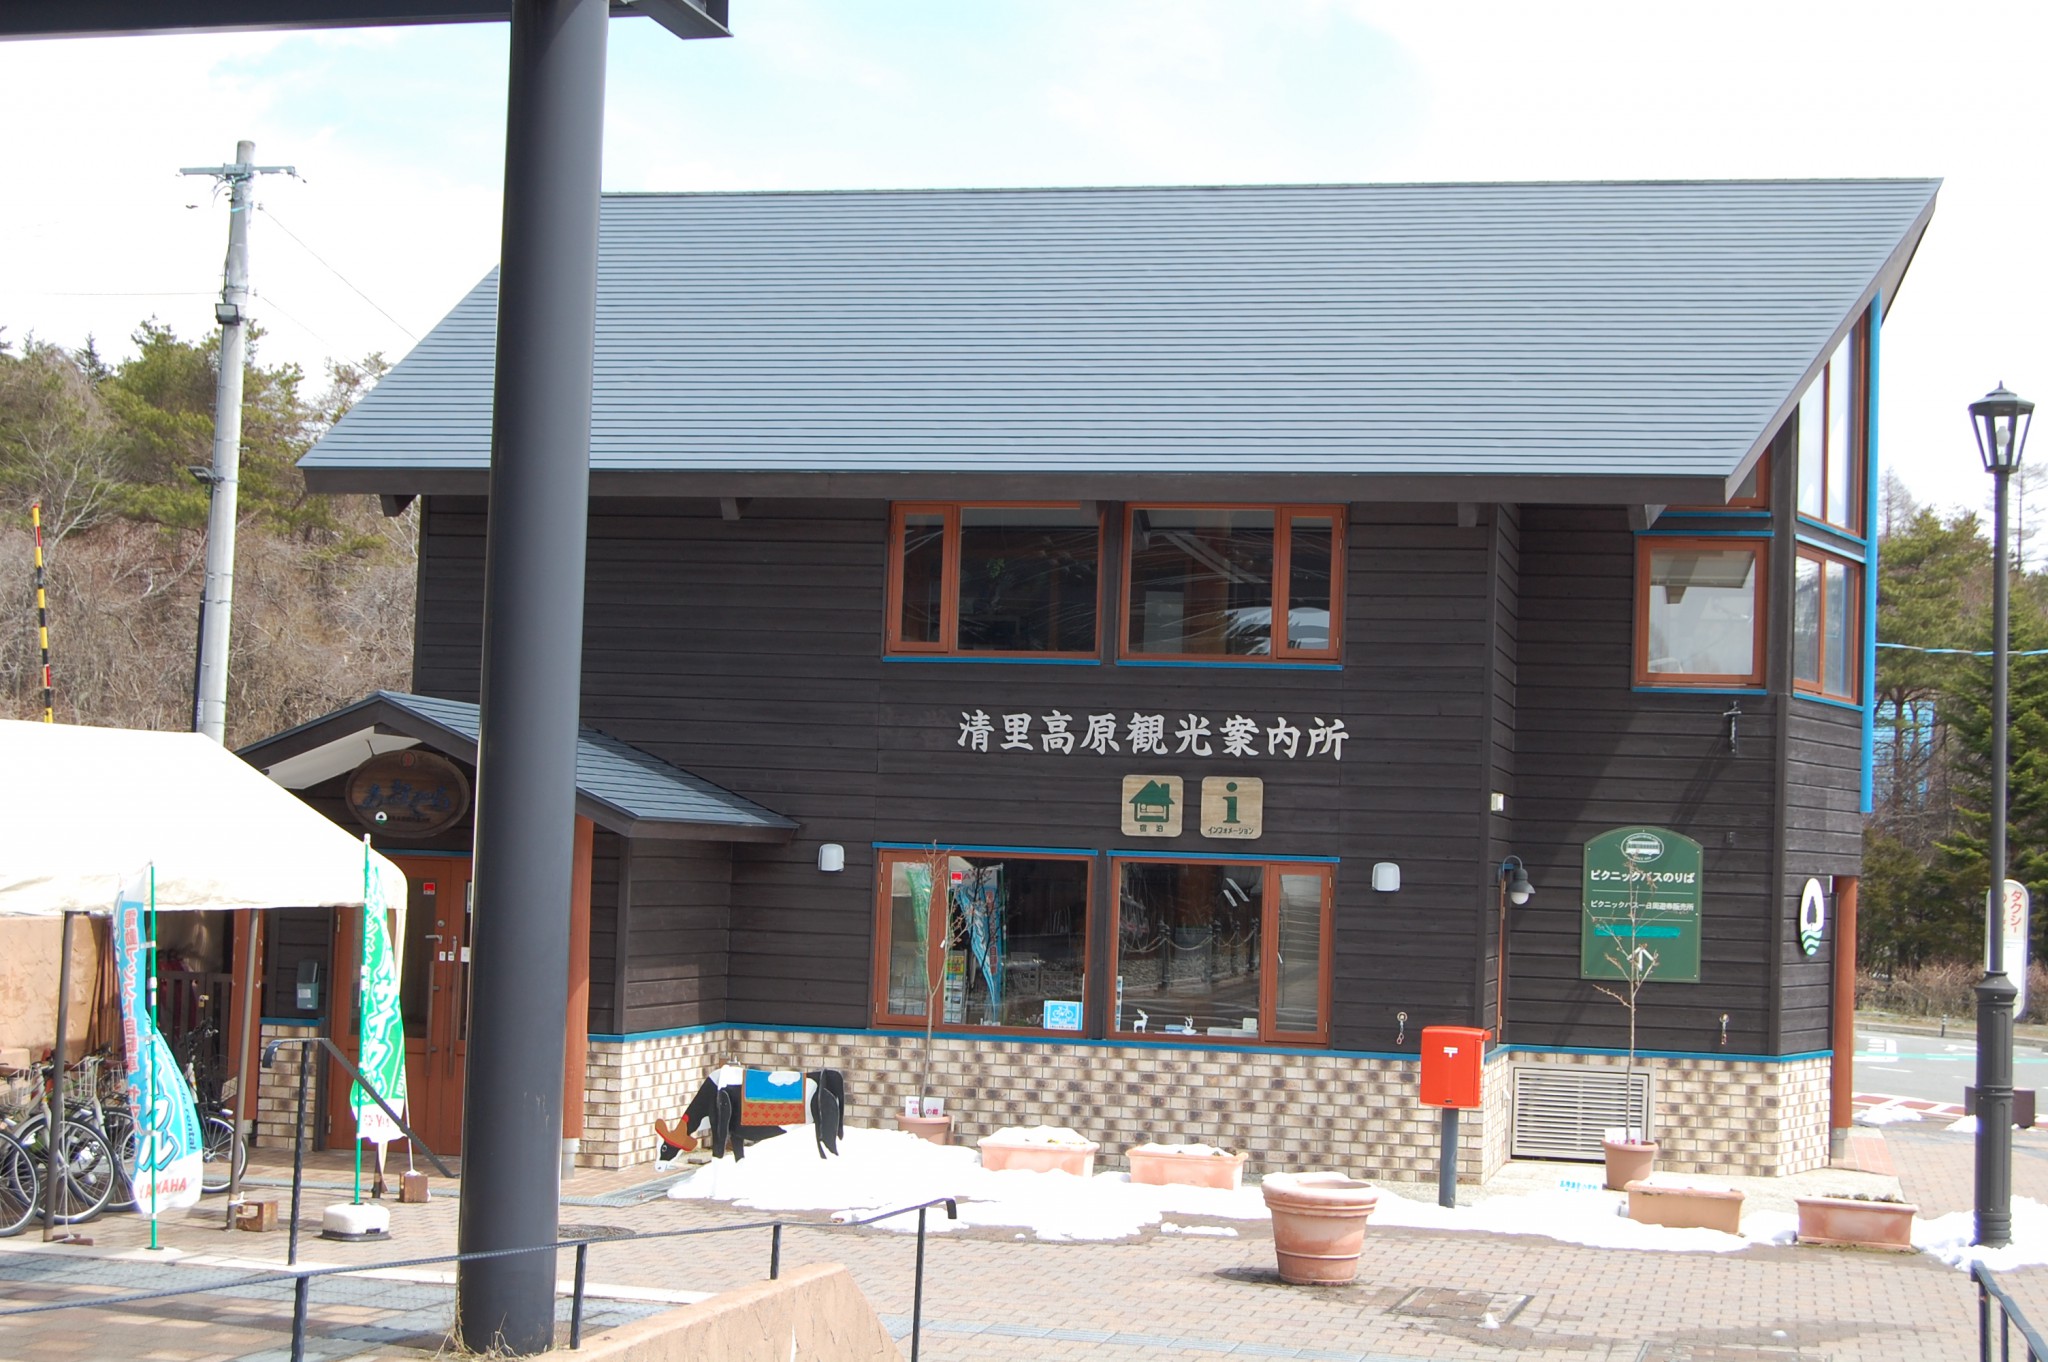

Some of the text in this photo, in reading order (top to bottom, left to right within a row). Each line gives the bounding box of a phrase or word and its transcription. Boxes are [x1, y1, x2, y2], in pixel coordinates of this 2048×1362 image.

[957, 709, 1350, 760] 清里高原観光案内所
[1139, 824, 1164, 833] 宿泊
[1208, 826, 1254, 835] インフォメーション
[2010, 890, 2022, 934] タクシー
